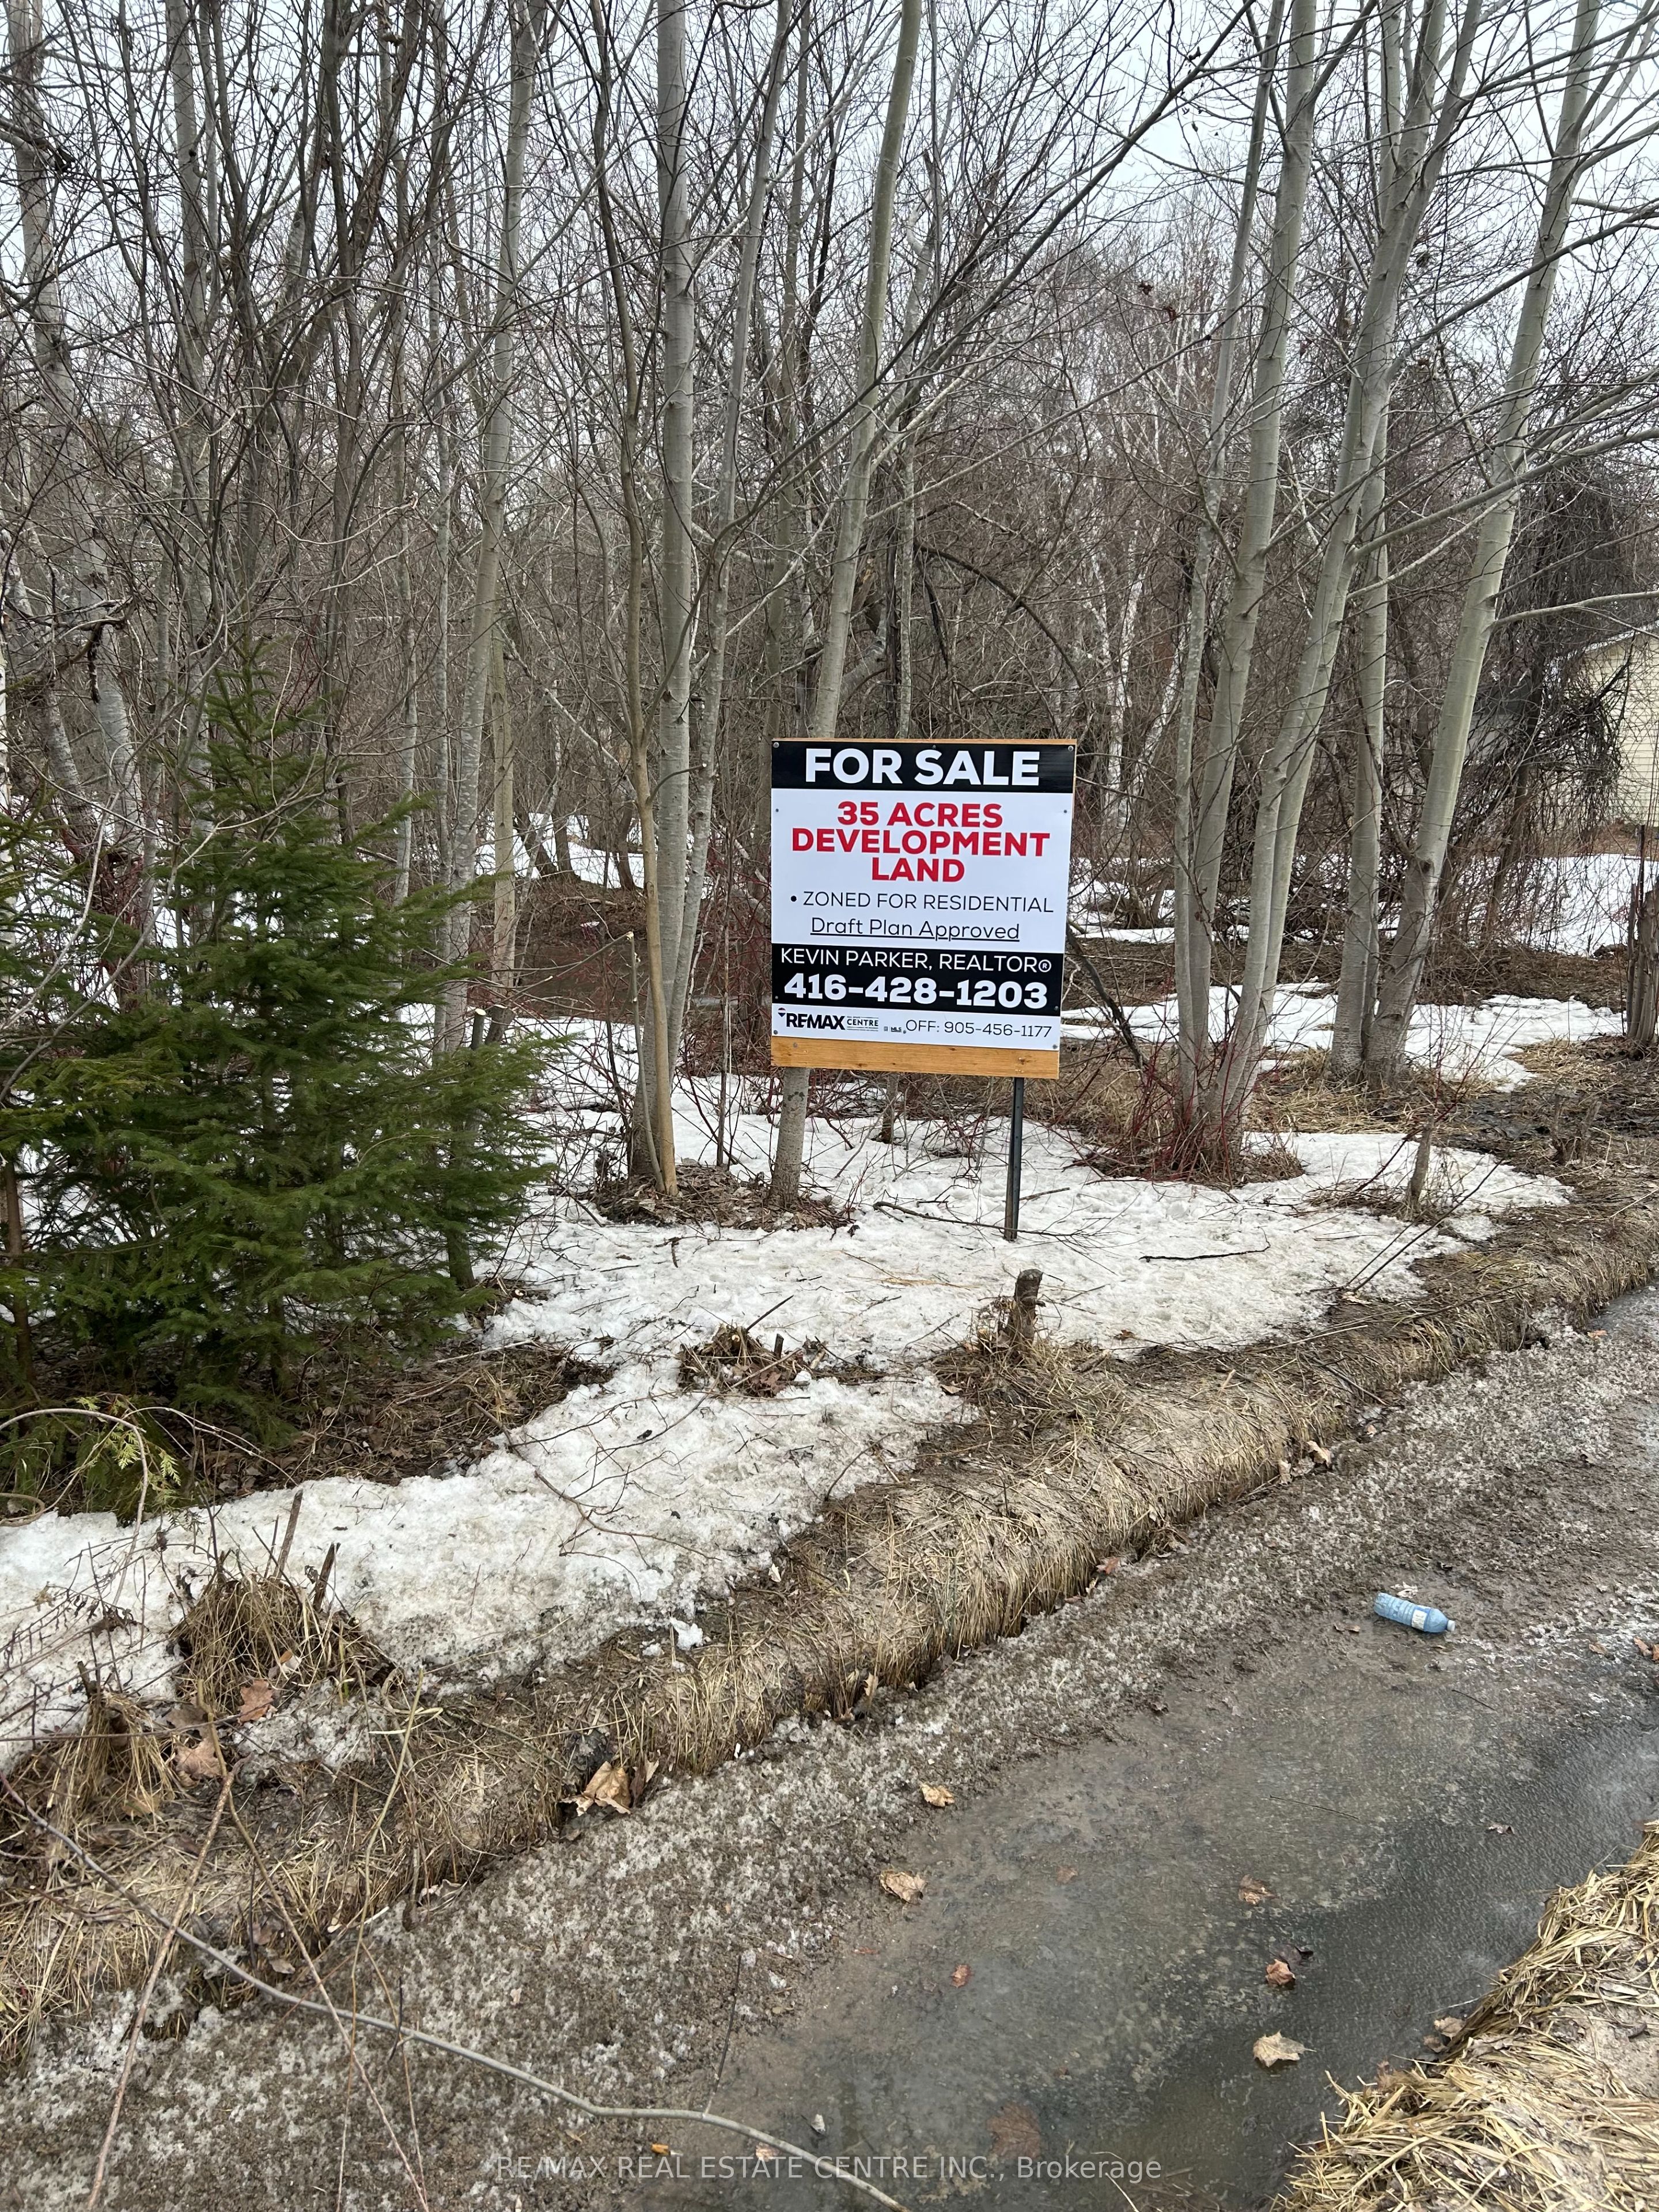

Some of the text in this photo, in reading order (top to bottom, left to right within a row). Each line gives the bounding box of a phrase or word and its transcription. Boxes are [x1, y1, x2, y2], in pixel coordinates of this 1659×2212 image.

[806, 748, 1040, 786] FOR SALE
[837, 801, 1003, 828] 35 ACRES
[792, 828, 1050, 857] DEVELOPMENT
[872, 858, 965, 882] LAND
[803, 891, 1054, 913] ZONED FOR RESIDENTIAL
[811, 917, 1020, 942] Draft Plan Approved
[781, 948, 839, 965] KEVIN
[846, 950, 933, 971] PARKER,
[784, 972, 1048, 1009] 416-428-1203
[846, 1018, 879, 1027] CENTRE
[906, 1020, 1052, 1037] OFF: 905-456-1177
